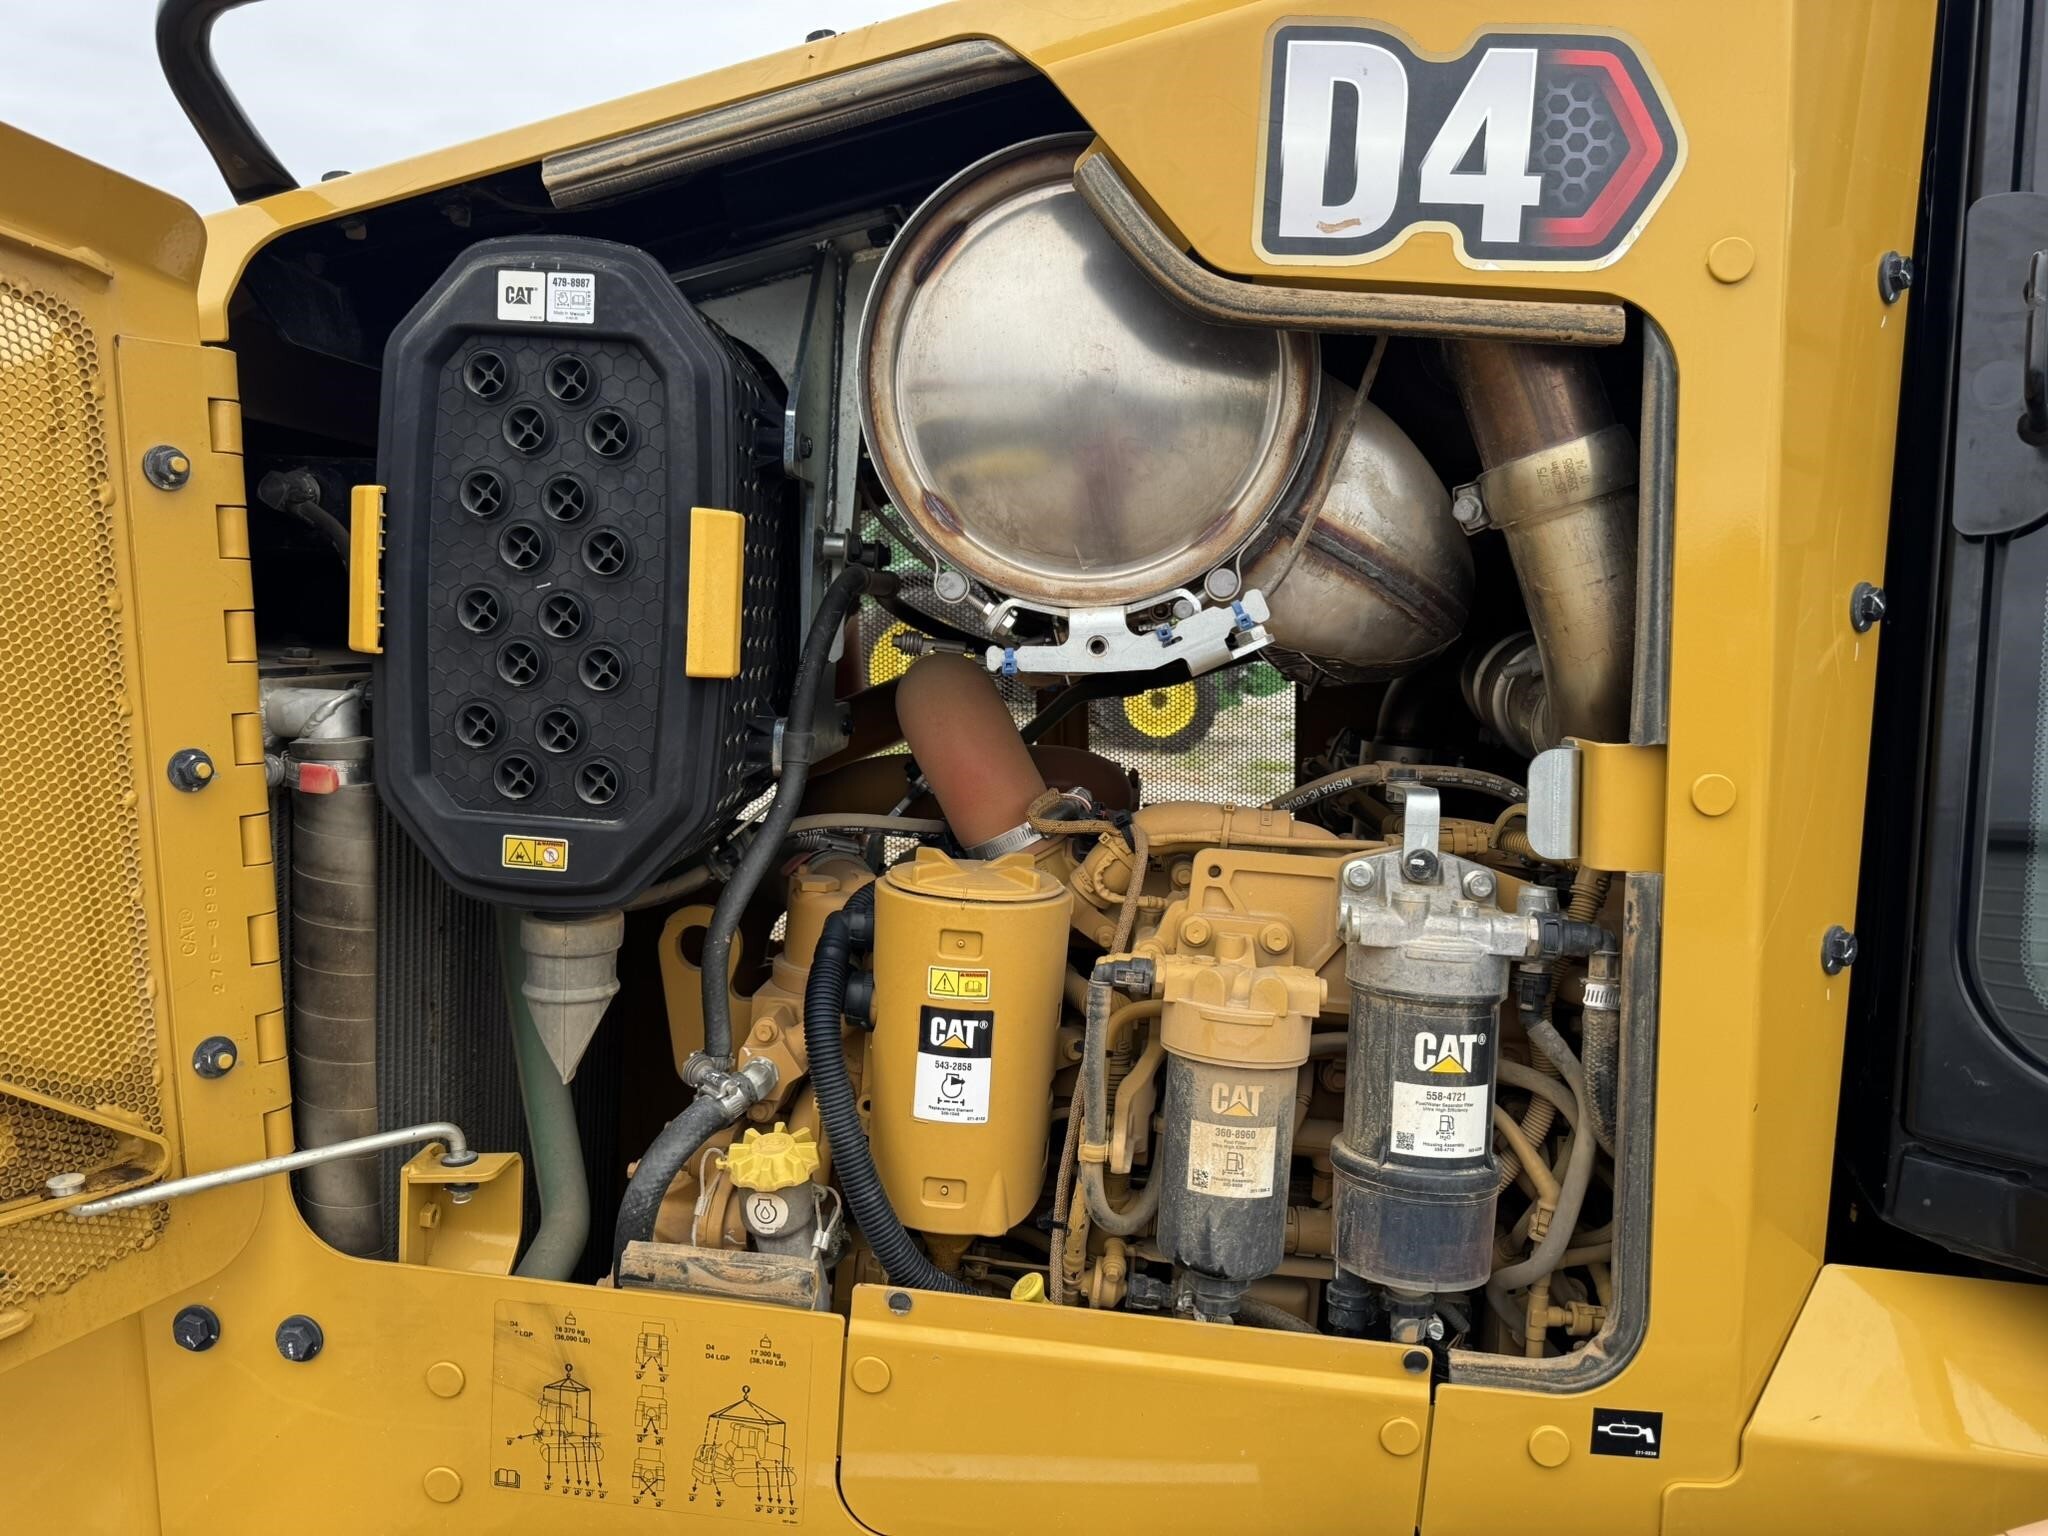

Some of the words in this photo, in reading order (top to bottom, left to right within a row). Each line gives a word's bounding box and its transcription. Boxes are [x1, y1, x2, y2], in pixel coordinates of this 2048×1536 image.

[1279, 40, 1542, 243] D4
[552, 277, 590, 288] 479-8987
[1320, 776, 1352, 794] MSHA
[935, 1060, 972, 1071] 543-2858
[1211, 1082, 1264, 1117] CAT
[1426, 1091, 1466, 1102] 558-4721
[1215, 1127, 1256, 1139] 360-8960
